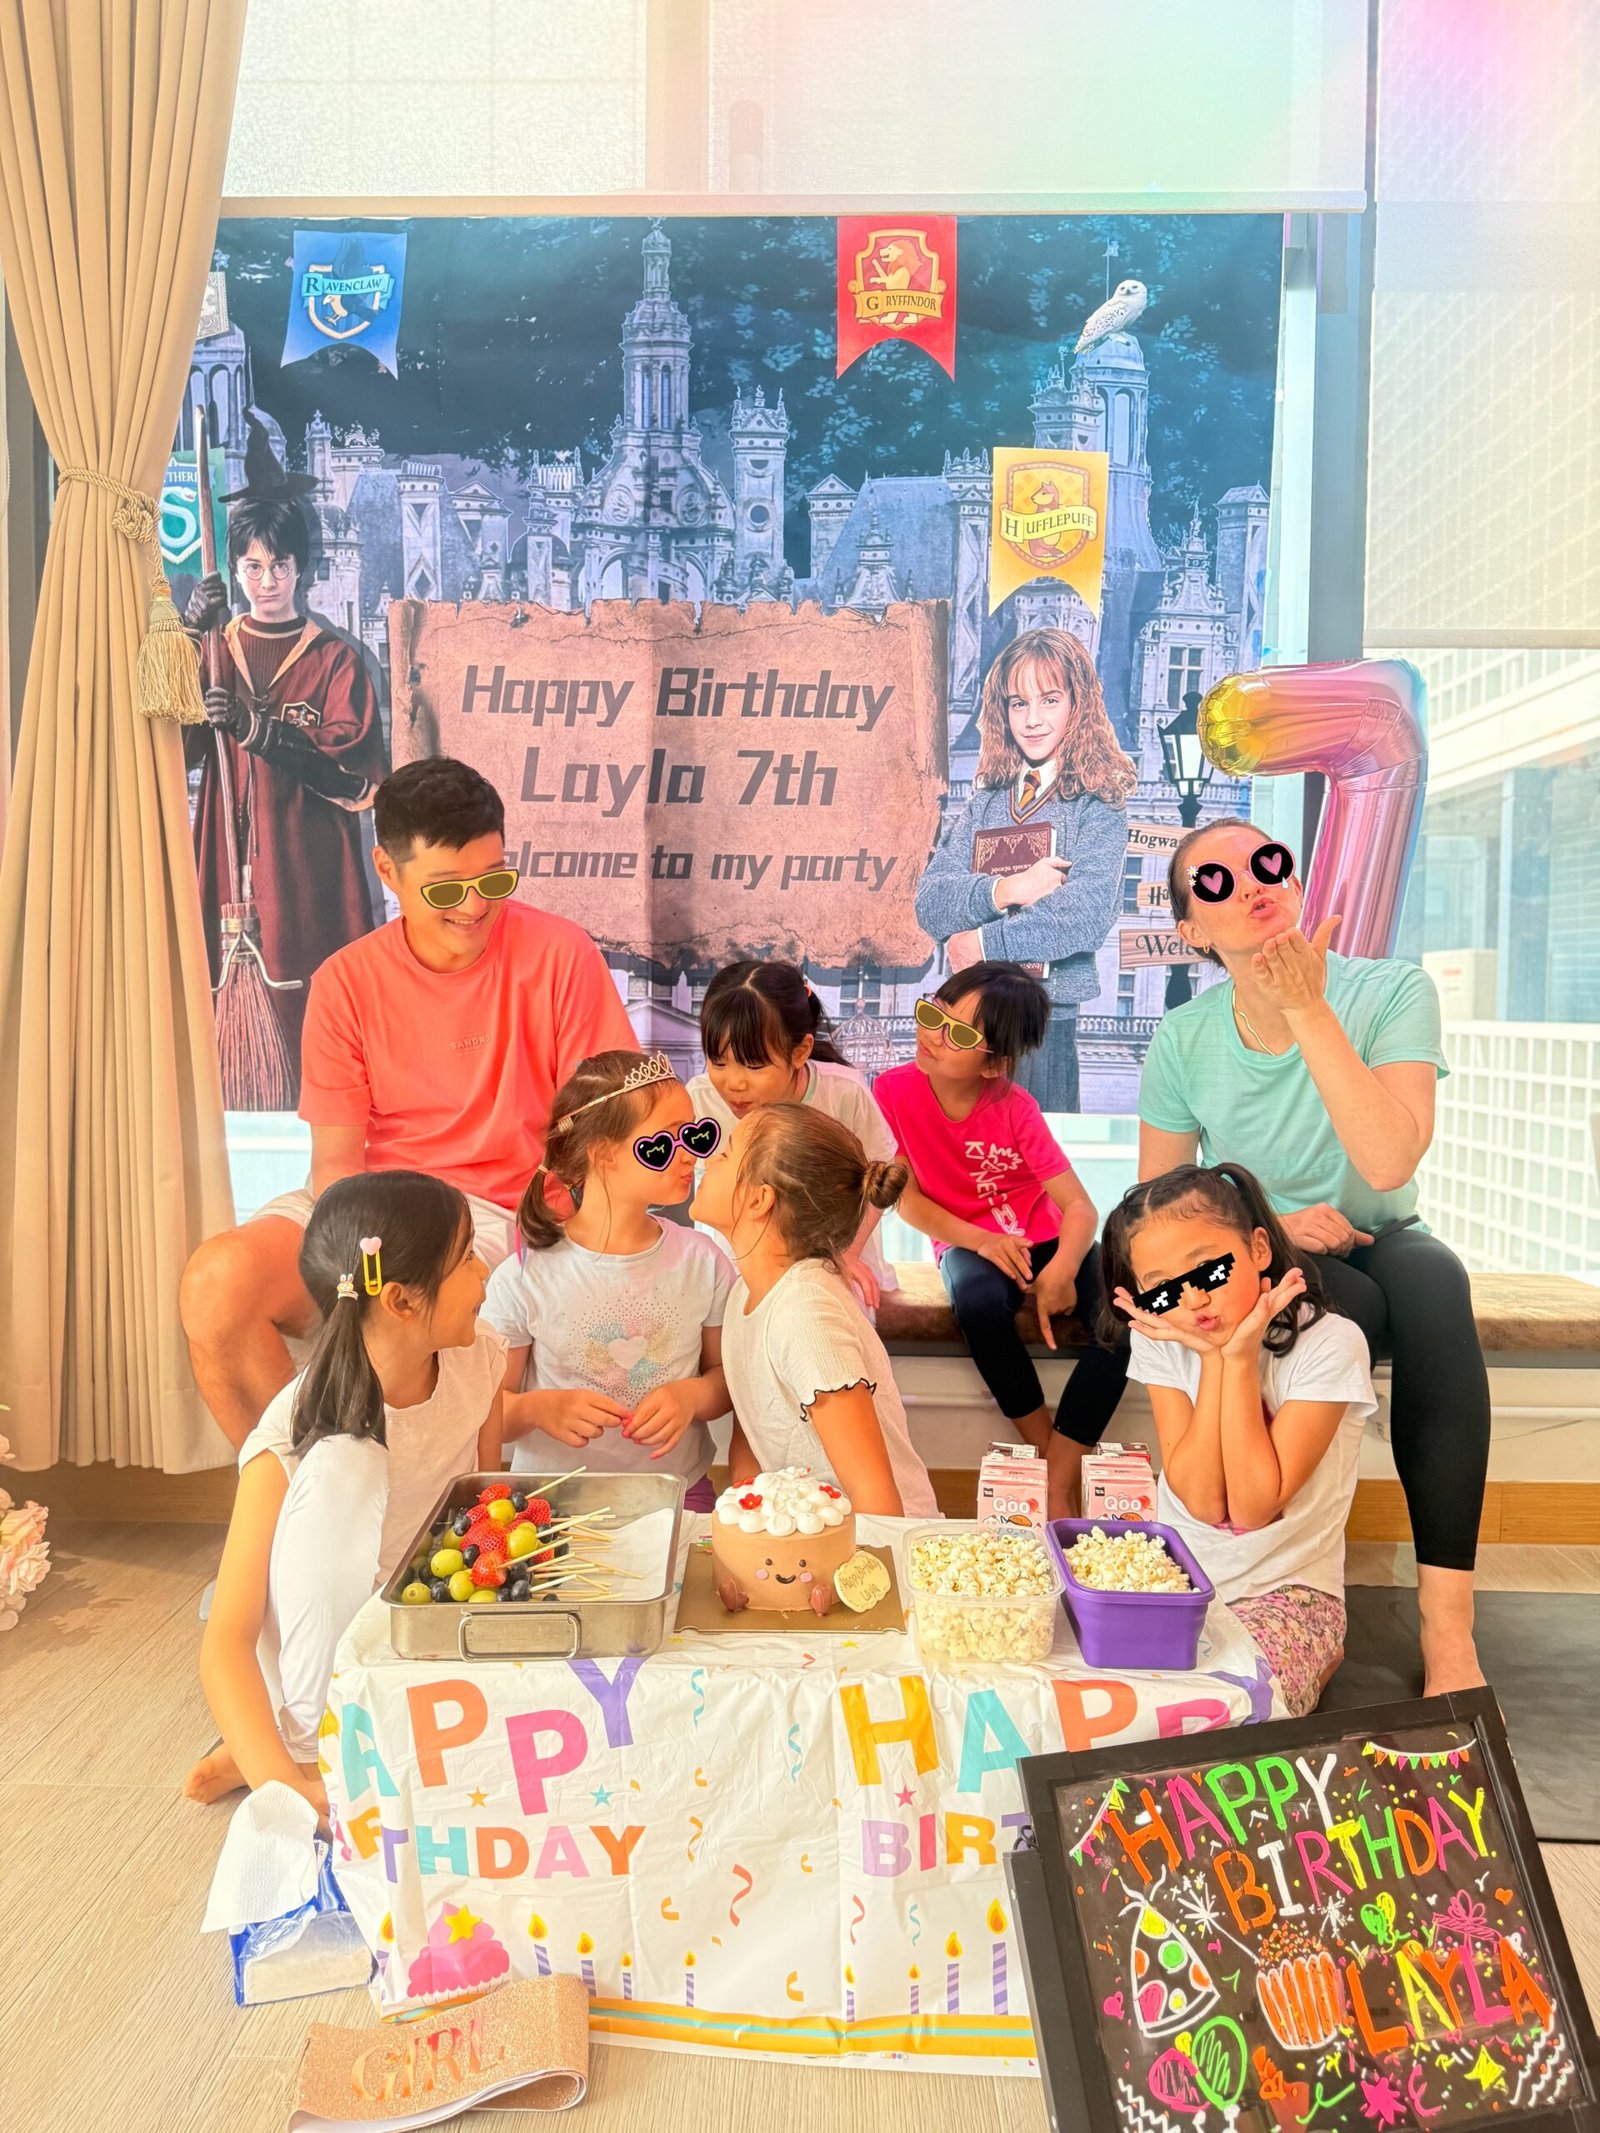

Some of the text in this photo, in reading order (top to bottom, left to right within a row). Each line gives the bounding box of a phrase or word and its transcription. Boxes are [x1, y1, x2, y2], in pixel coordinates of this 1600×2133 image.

[305, 277, 382, 292] RAVENCLAW
[866, 295, 937, 311] GRYFFINDOR
[1005, 512, 1094, 538] HUFFLEPUFF
[462, 664, 896, 732] Happy Birthday
[520, 746, 838, 818] Layla 7th
[651, 845, 694, 879] to
[710, 853, 773, 890] my
[780, 848, 898, 891] party
[1108, 1753, 1337, 1884] HAPPY
[1212, 1787, 1488, 1935] BIRTHDAY
[1346, 1936, 1553, 2057] LAYLA
[351, 2019, 504, 2102] GIRL
